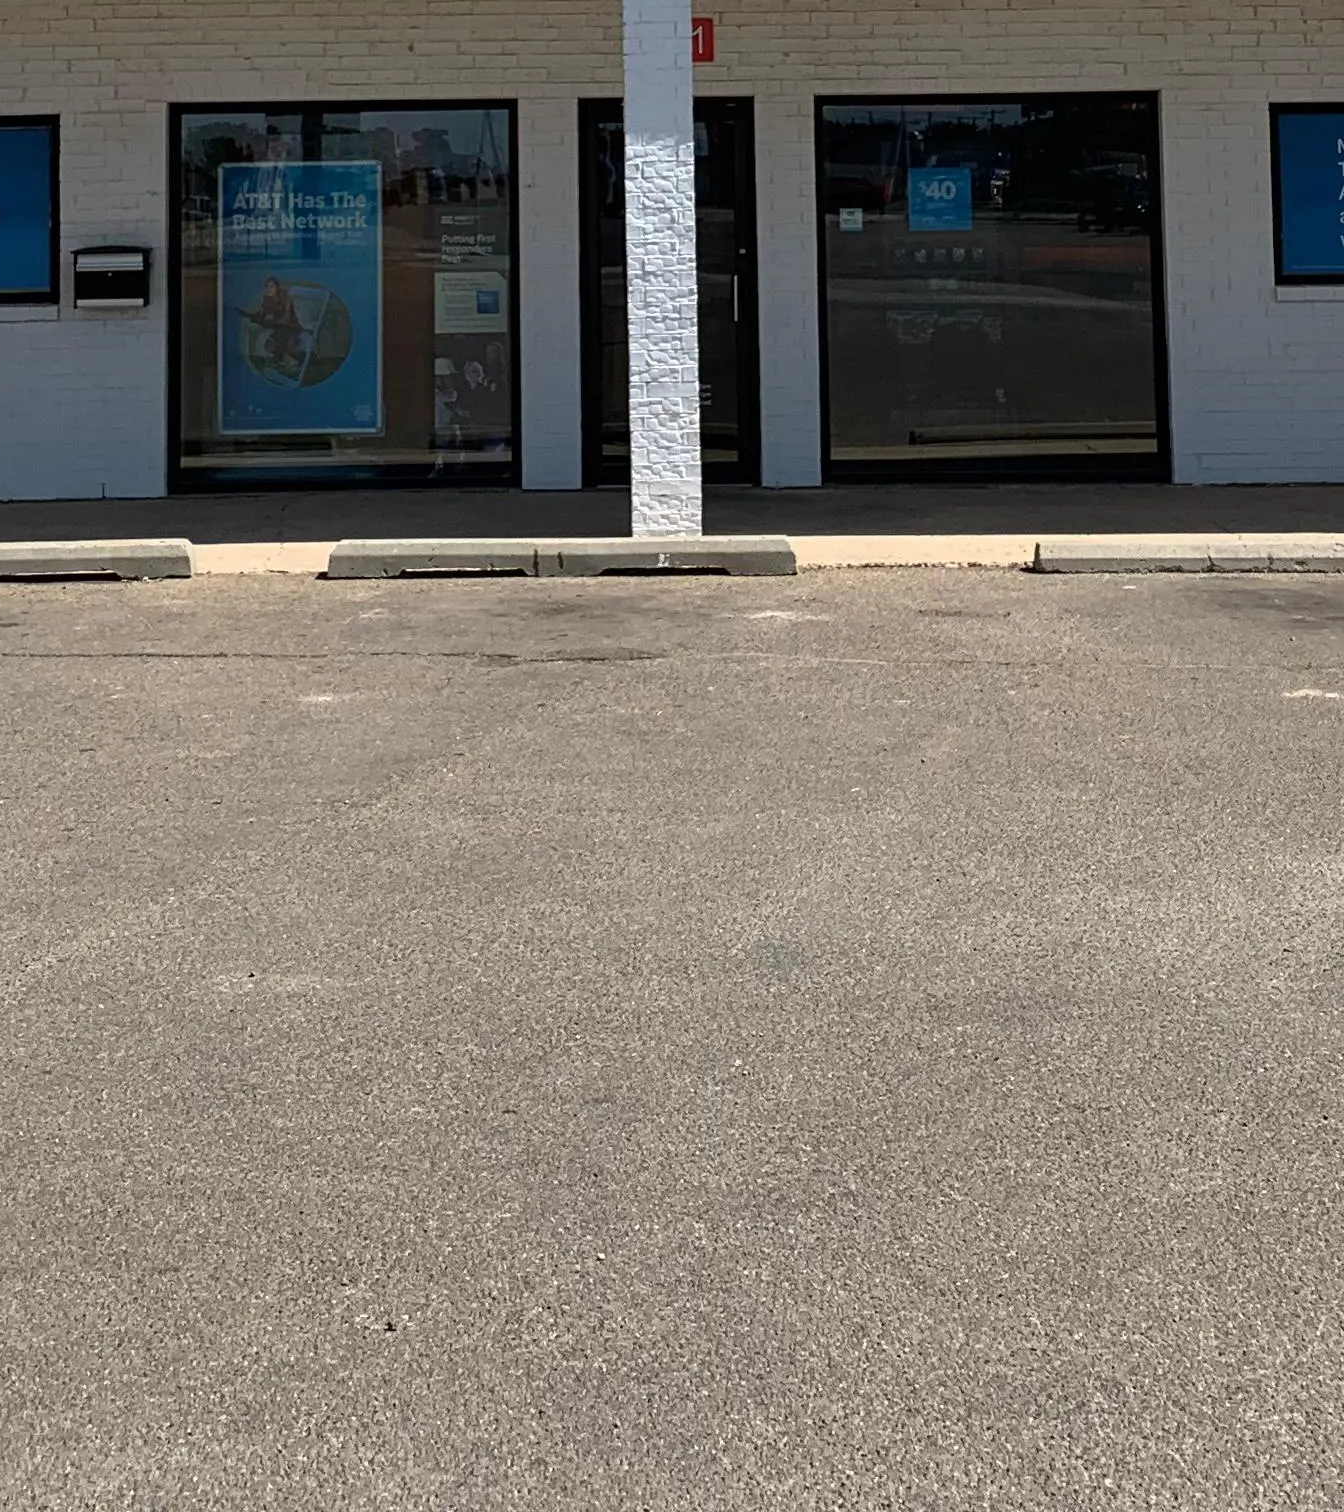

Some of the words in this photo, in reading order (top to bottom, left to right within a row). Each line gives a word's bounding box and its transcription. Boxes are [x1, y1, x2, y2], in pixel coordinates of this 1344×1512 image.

[232, 191, 285, 210] AT&T
[288, 192, 325, 209] Has
[330, 191, 366, 208] The
[280, 212, 368, 230] Network
